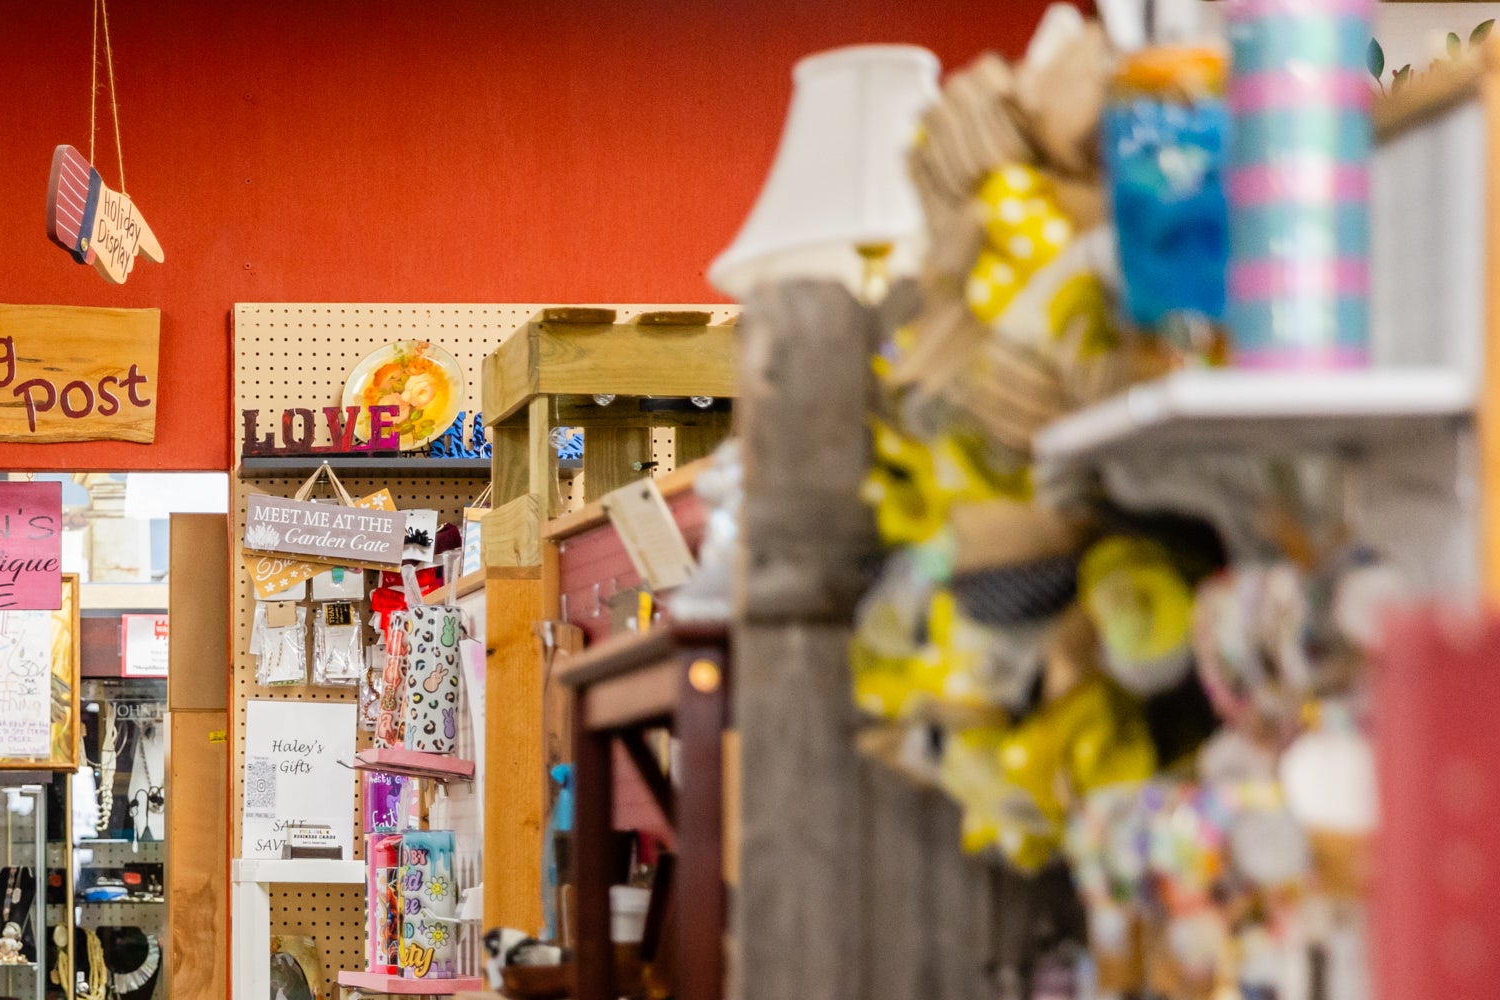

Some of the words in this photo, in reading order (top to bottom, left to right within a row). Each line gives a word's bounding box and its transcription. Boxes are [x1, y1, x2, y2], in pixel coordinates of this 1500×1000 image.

[104, 190, 141, 256] Holiday
[97, 219, 131, 278] Display
[13, 363, 151, 432] post
[241, 404, 400, 452] LOVE
[253, 505, 301, 525] MEET
[303, 510, 330, 528] ME
[332, 513, 355, 530] AT
[357, 515, 393, 534] THE
[284, 528, 346, 549] Garden
[350, 534, 390, 553] Gate
[272, 740, 325, 756] Haley's
[279, 759, 313, 775] Gifts
